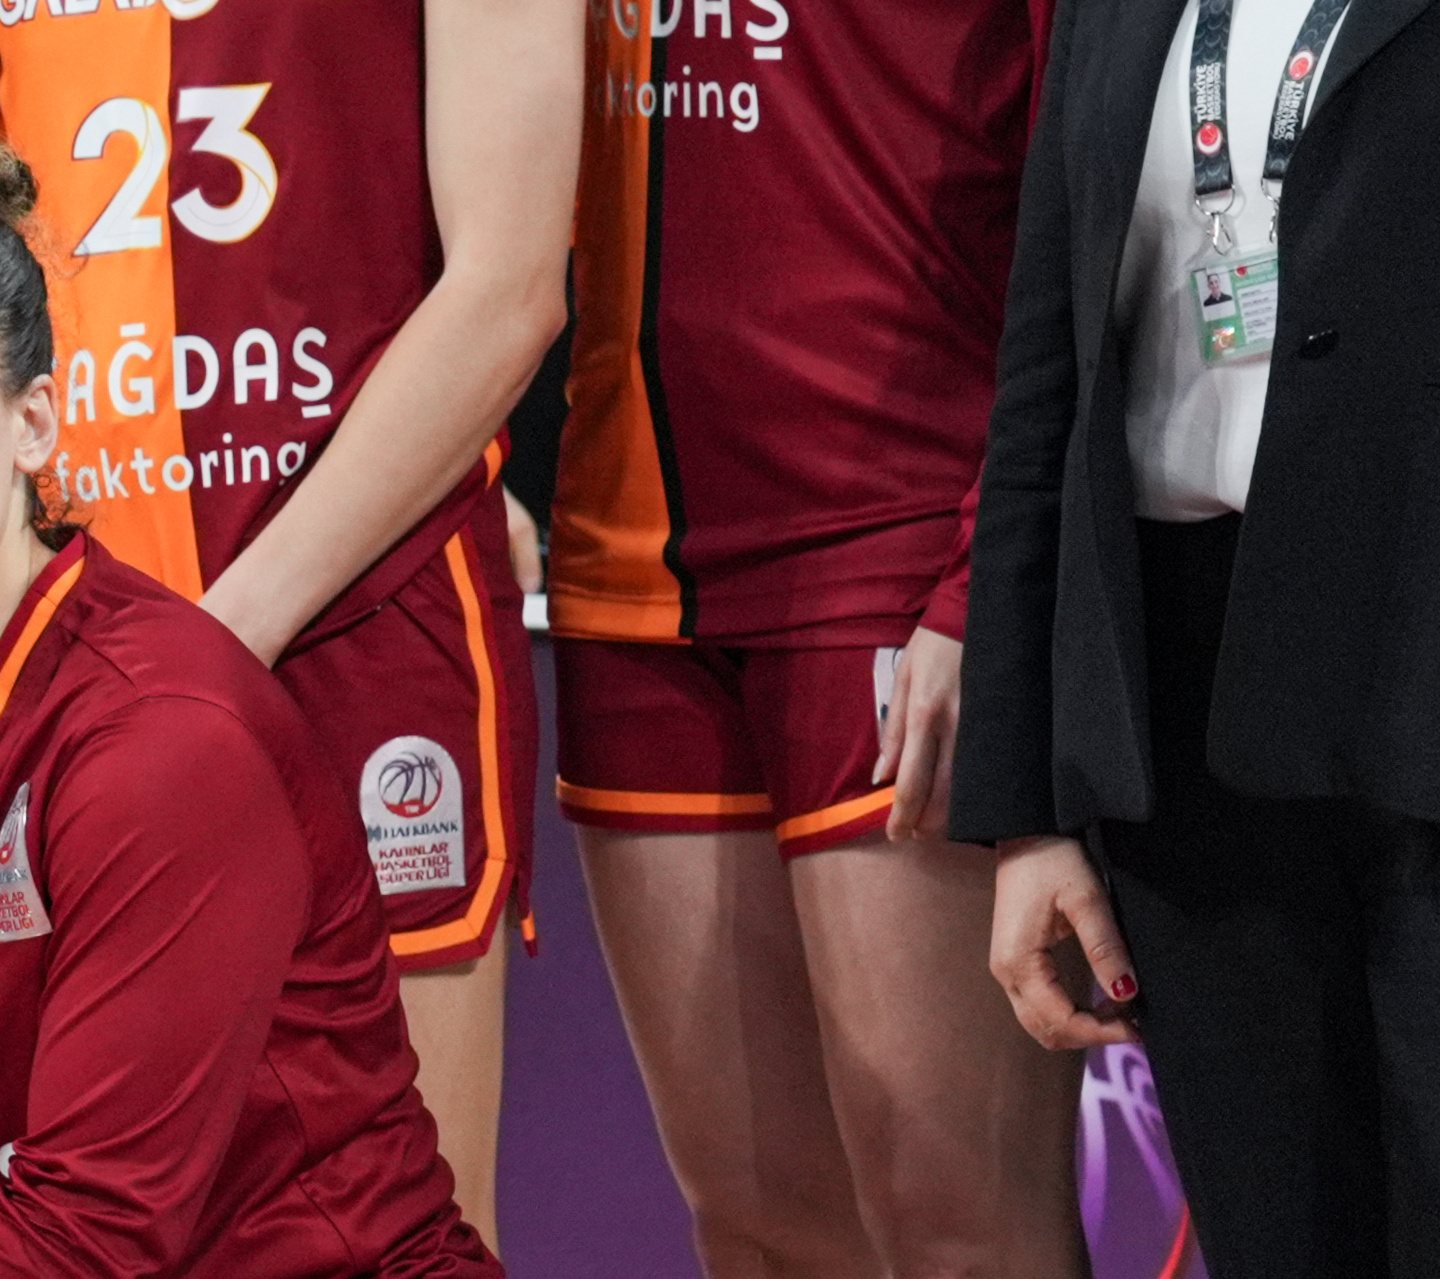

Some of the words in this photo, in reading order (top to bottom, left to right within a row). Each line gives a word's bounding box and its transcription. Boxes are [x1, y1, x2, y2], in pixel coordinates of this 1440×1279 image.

[1194, 64, 1207, 123] TÜRKİYE
[72, 83, 278, 257] 23
[65, 322, 334, 424] AĞDAŞ
